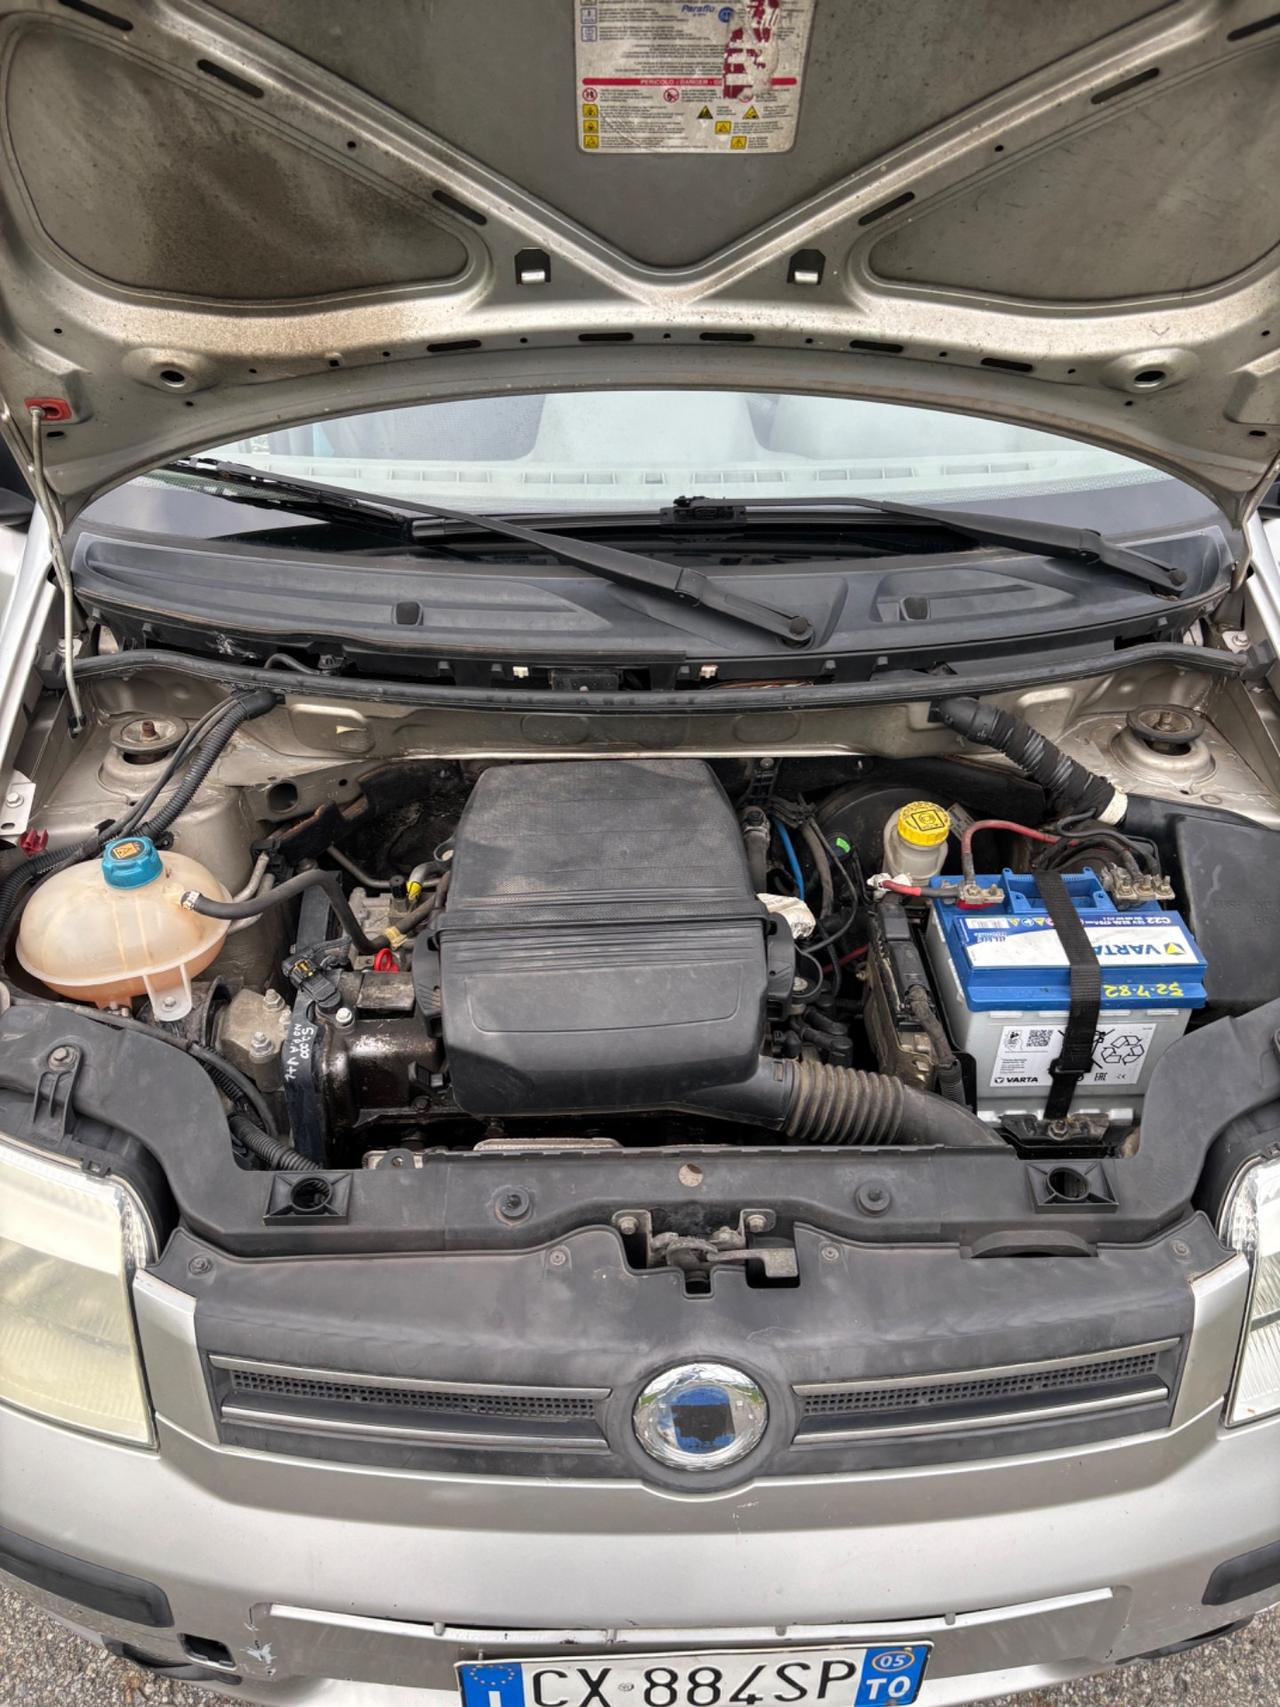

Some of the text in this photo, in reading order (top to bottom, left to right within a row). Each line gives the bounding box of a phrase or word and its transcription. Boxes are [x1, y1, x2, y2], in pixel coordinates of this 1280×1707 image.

[1093, 944, 1161, 955] VARTA
[880, 1655, 906, 1667] 05
[532, 1667, 612, 1707] CX
[643, 1660, 857, 1707] 884SP
[866, 1676, 911, 1700] TO
